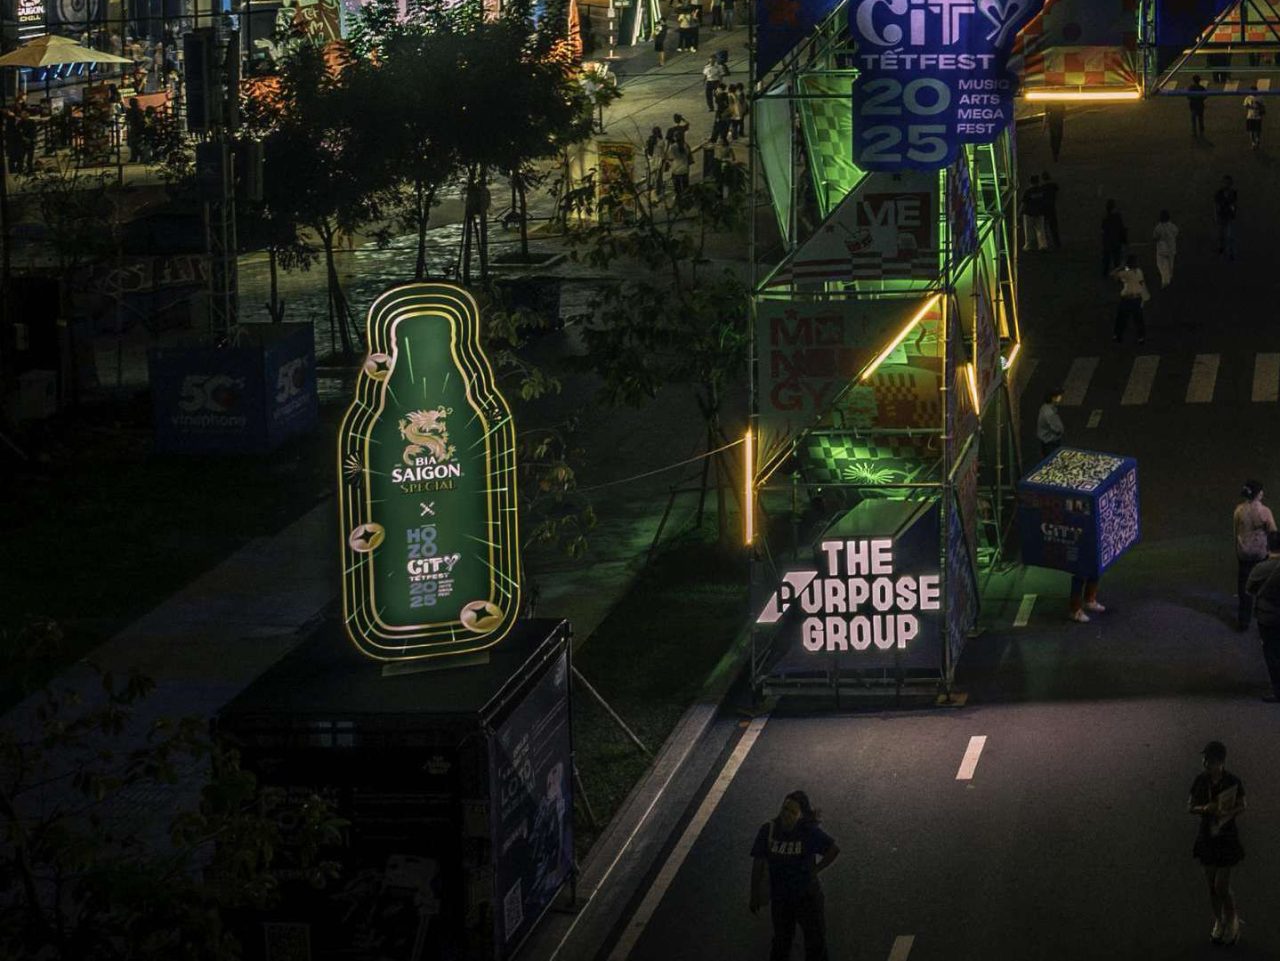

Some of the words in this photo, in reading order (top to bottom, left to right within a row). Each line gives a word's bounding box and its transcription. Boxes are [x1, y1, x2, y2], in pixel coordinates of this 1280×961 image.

[958, 79, 1010, 90] MUSIC
[861, 77, 951, 116] 20
[959, 94, 1001, 105] ARTS
[957, 108, 1005, 120] MEGA
[956, 123, 996, 134] FEST
[859, 124, 949, 163] 25
[415, 456, 437, 467] BIA
[391, 463, 461, 483] SAIGON
[400, 480, 456, 494] SPECIAL
[821, 540, 893, 576] THE
[410, 581, 437, 595] 20
[410, 594, 437, 609] 25
[756, 570, 940, 624] PURPOSE
[802, 613, 919, 652] GROUP
